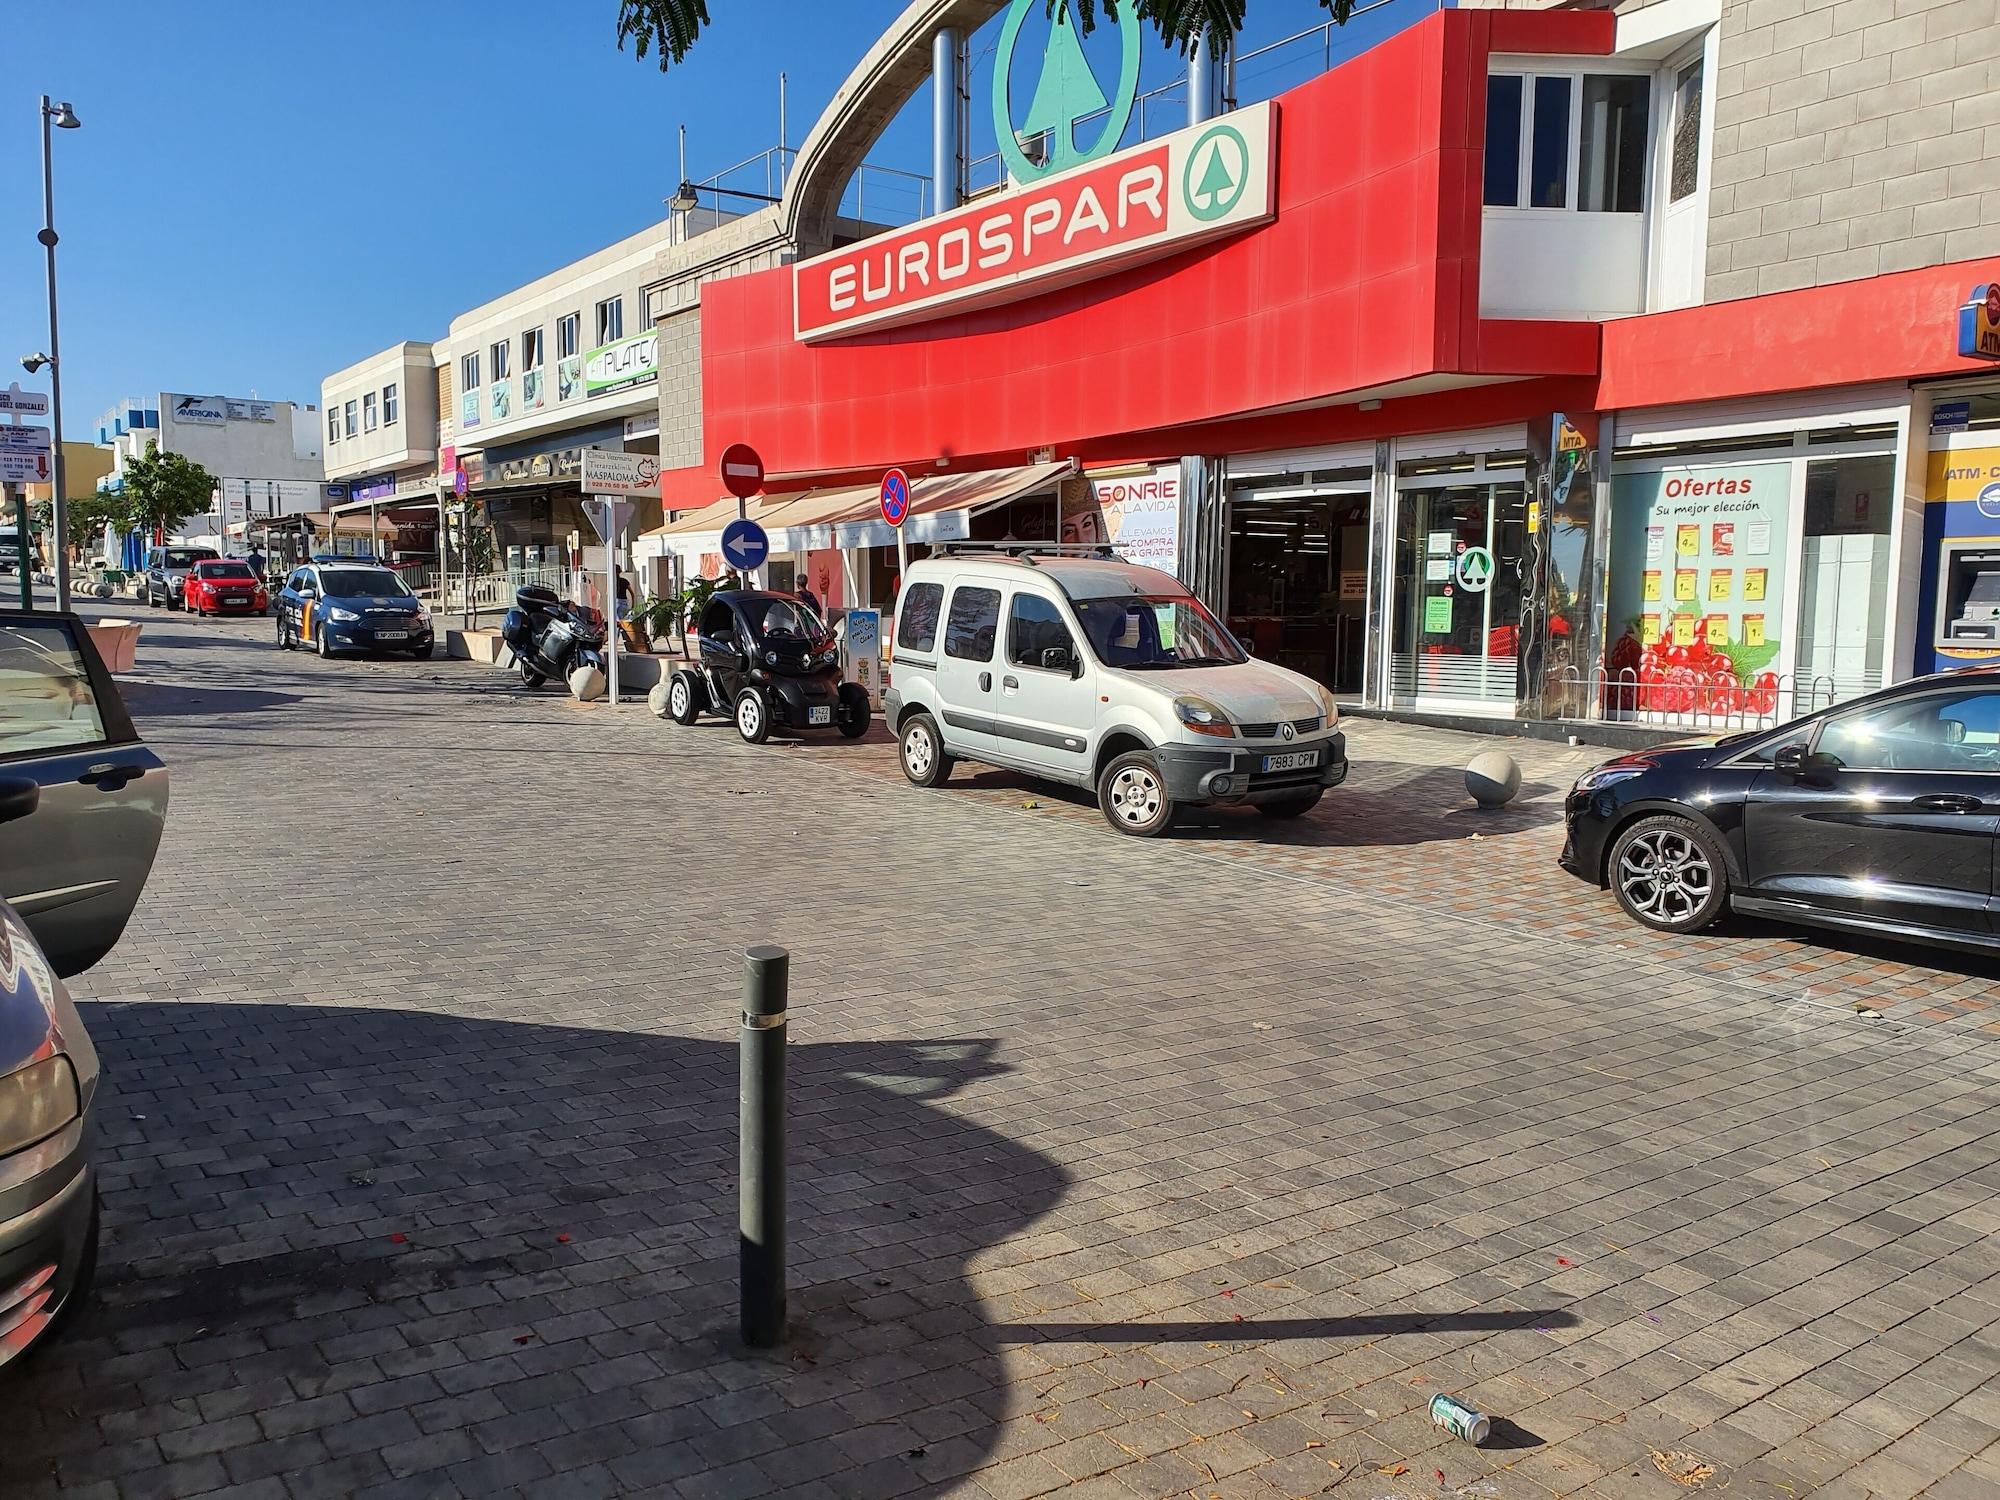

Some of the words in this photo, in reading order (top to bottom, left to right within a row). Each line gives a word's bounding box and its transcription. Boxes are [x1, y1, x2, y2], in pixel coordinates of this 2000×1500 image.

[828, 164, 1164, 313] EUROSPAR
[177, 408, 223, 419] AMERICANA
[586, 470, 639, 482] MASPALOMAS
[1944, 467, 1980, 480] ATM
[1098, 480, 1178, 504] SONRIE
[1665, 478, 1752, 498] Ofertas
[1111, 504, 1121, 515] A
[1123, 502, 1143, 514] LA
[1145, 500, 1177, 513] VIDA
[1656, 505, 1670, 516] Su
[1674, 501, 1710, 517] mejor
[1713, 499, 1760, 512] elección
[1121, 527, 1175, 538] LLEVAMOS
[1130, 537, 1174, 548] COMPRA
[814, 707, 829, 715] 3422
[1270, 755, 1294, 769] 7983
